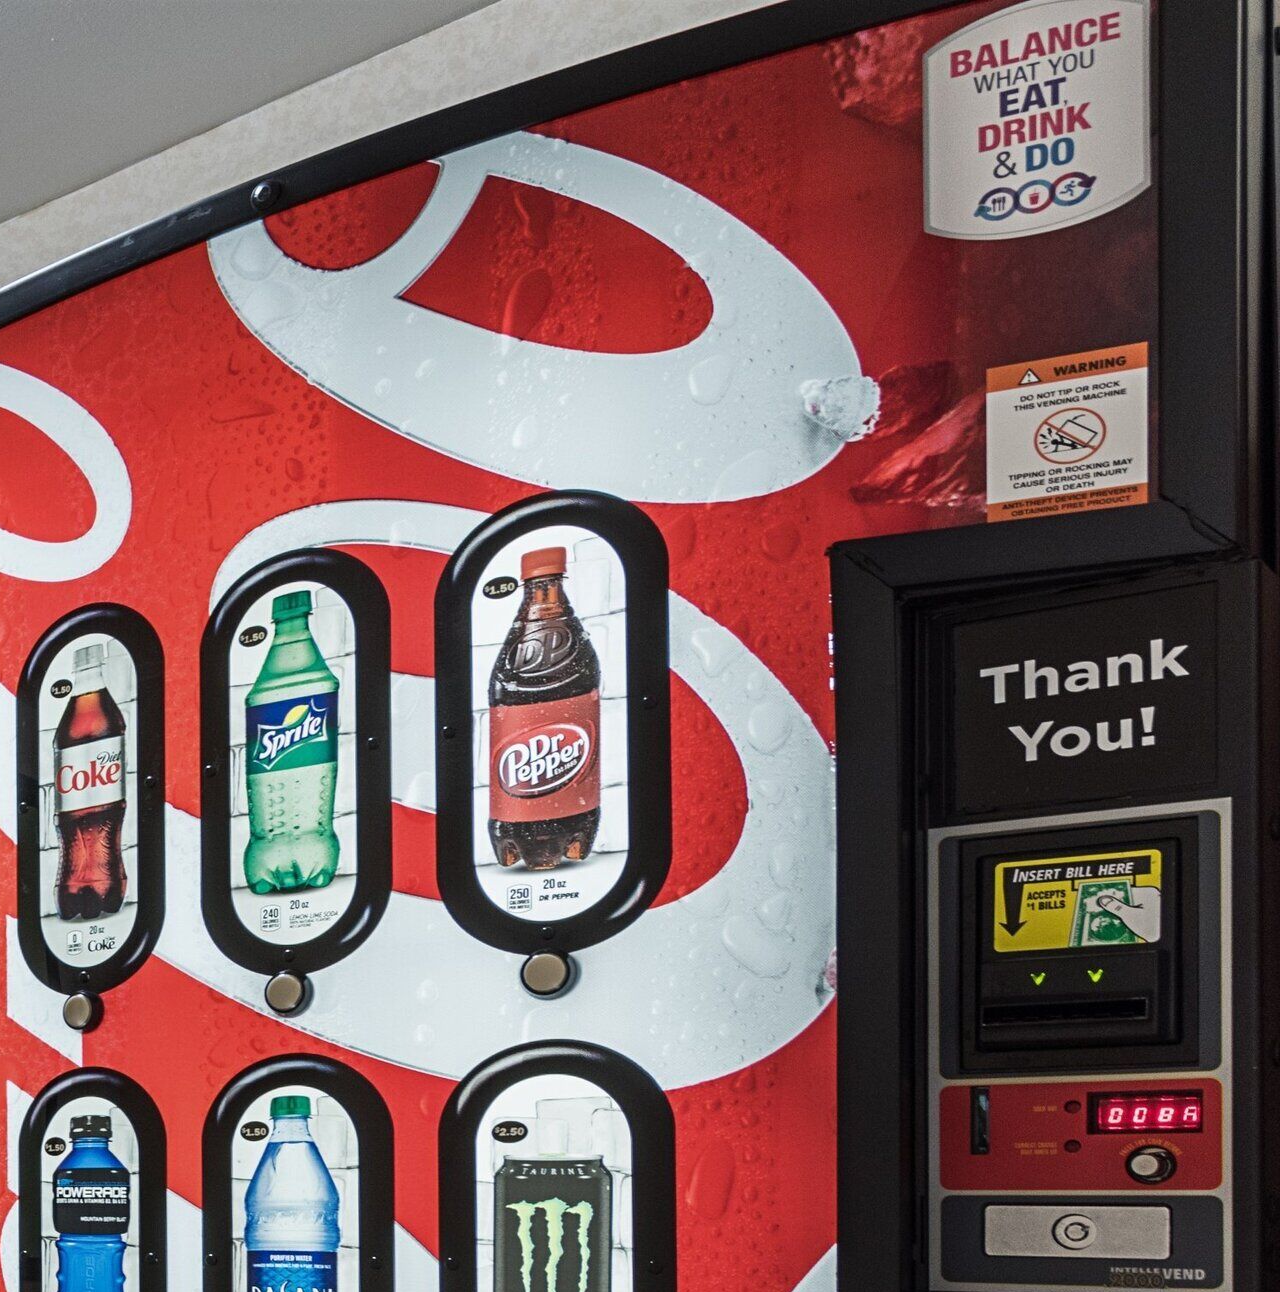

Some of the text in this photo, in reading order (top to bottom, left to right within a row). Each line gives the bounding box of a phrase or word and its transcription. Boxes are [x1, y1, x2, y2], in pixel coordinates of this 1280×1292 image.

[950, 12, 1121, 78] BALANCE
[974, 49, 1094, 94] WHAT YOU
[978, 102, 1092, 152] DRINK
[993, 138, 1074, 178] & DO
[1054, 356, 1127, 377] WARNING
[1020, 394, 1033, 402] DO
[1058, 388, 1072, 397] TIP
[1076, 385, 1089, 393] OR
[1092, 380, 1120, 390] ROCK
[1014, 388, 1127, 411] THIS VENDING MACHINE
[1009, 470, 1045, 482] TIPPING
[1065, 462, 1109, 473] ROCKING
[1113, 458, 1133, 466] MAY
[1013, 468, 1128, 489] CAUSE SERIOUS INJURY
[1046, 481, 1094, 493] OR DEATH
[1055, 493, 1088, 503] DEVICE
[1090, 486, 1138, 498] PREVENTS
[1061, 502, 1084, 510] FREE
[1087, 495, 1131, 506] PRODUCT
[484, 582, 515, 595] $1.50
[240, 629, 265, 643] $1.50
[980, 638, 1189, 704] Thank
[259, 716, 322, 760] Sprite
[1008, 706, 1156, 762] You!
[529, 734, 564, 758] Dr
[97, 750, 122, 765] Diet
[504, 739, 584, 787] Pepper
[56, 760, 121, 794] Coke
[1013, 862, 1134, 883] INSERT BILL HERE
[543, 879, 555, 889] 20
[510, 888, 529, 899] 250
[552, 892, 579, 900] PEPPER
[1027, 889, 1066, 901] ACCEPTS
[290, 900, 300, 909] 20
[1038, 900, 1066, 911] BILLS
[263, 909, 278, 919] 240
[89, 926, 97, 934] 20
[88, 940, 115, 952] Coke
[241, 1126, 267, 1137] $1.50
[495, 1127, 525, 1136] $2.50
[522, 1168, 584, 1176] TAURINE
[56, 1187, 127, 1198] POWERADE
